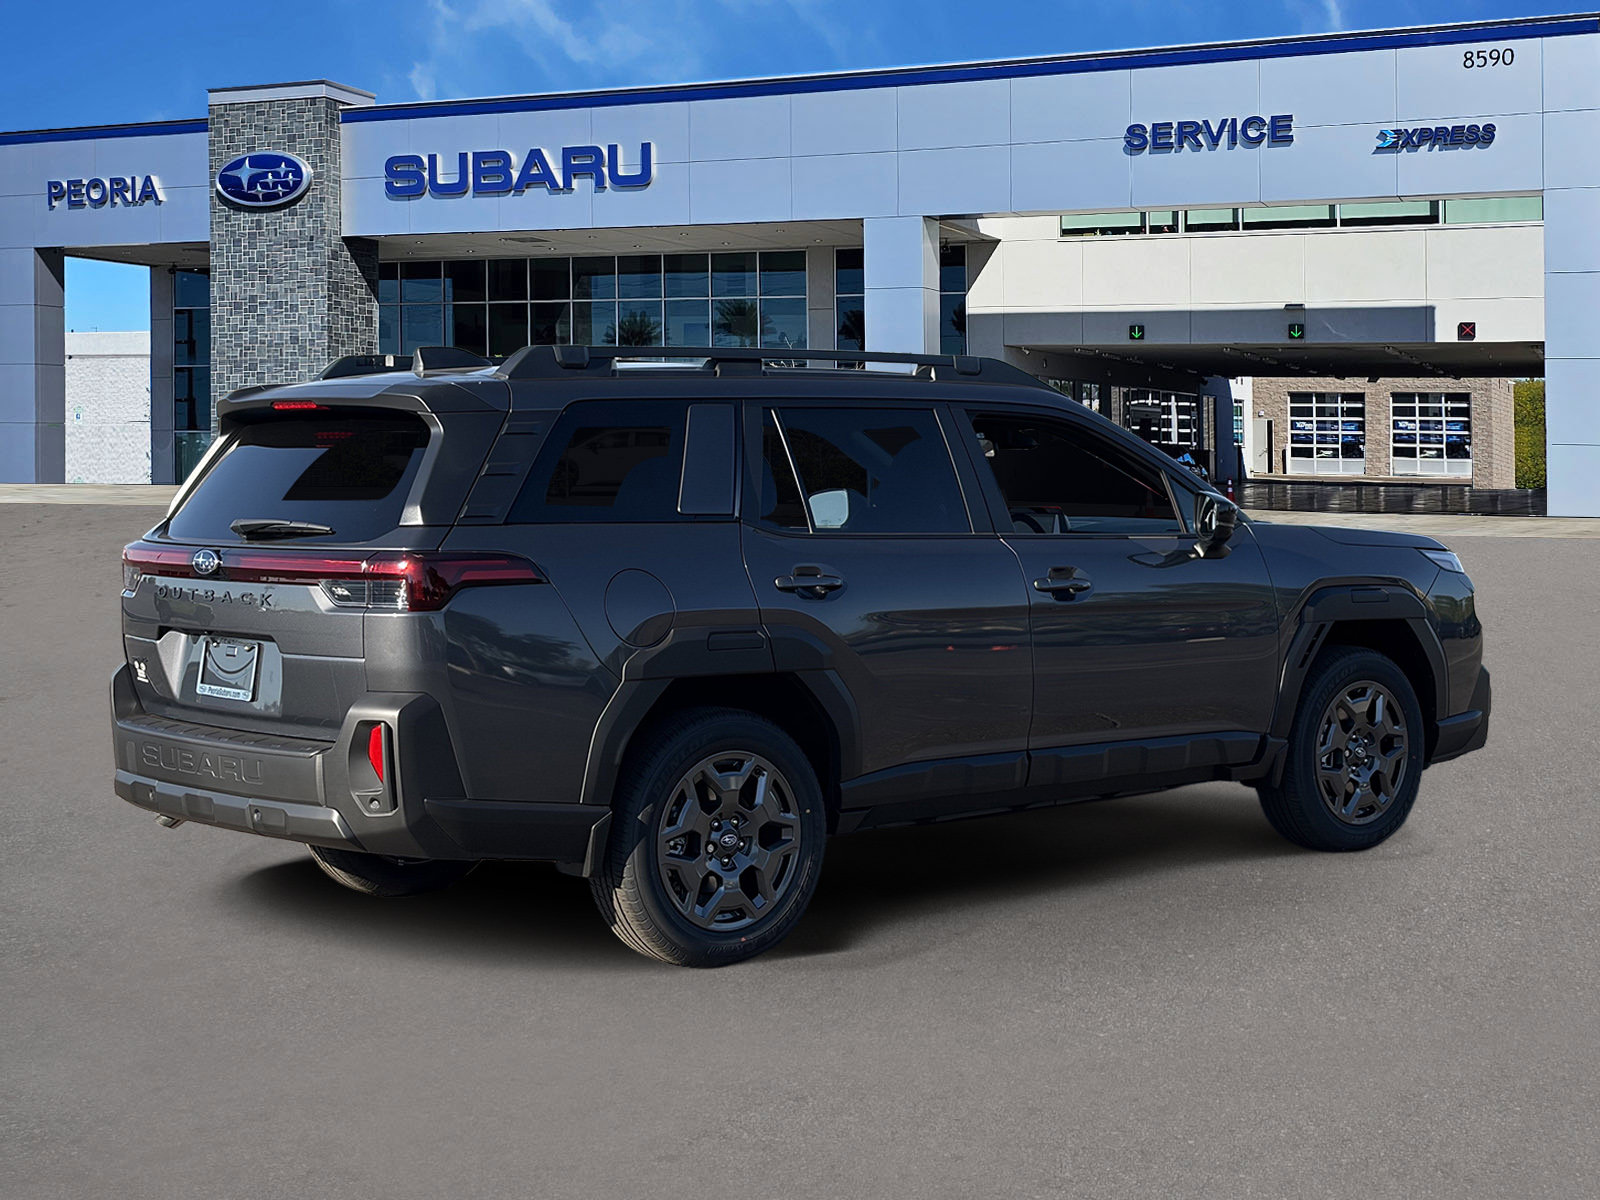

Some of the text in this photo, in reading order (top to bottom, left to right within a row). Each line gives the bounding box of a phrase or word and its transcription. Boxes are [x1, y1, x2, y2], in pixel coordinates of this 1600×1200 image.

[1463, 47, 1515, 69] 8590
[1124, 114, 1294, 152] SERVICE
[1375, 121, 1497, 150] EXPRESS
[384, 141, 654, 198] SUBARU
[47, 174, 162, 208] PEORIA
[157, 586, 274, 608] OUTBACK
[141, 743, 265, 786] SUBARU
